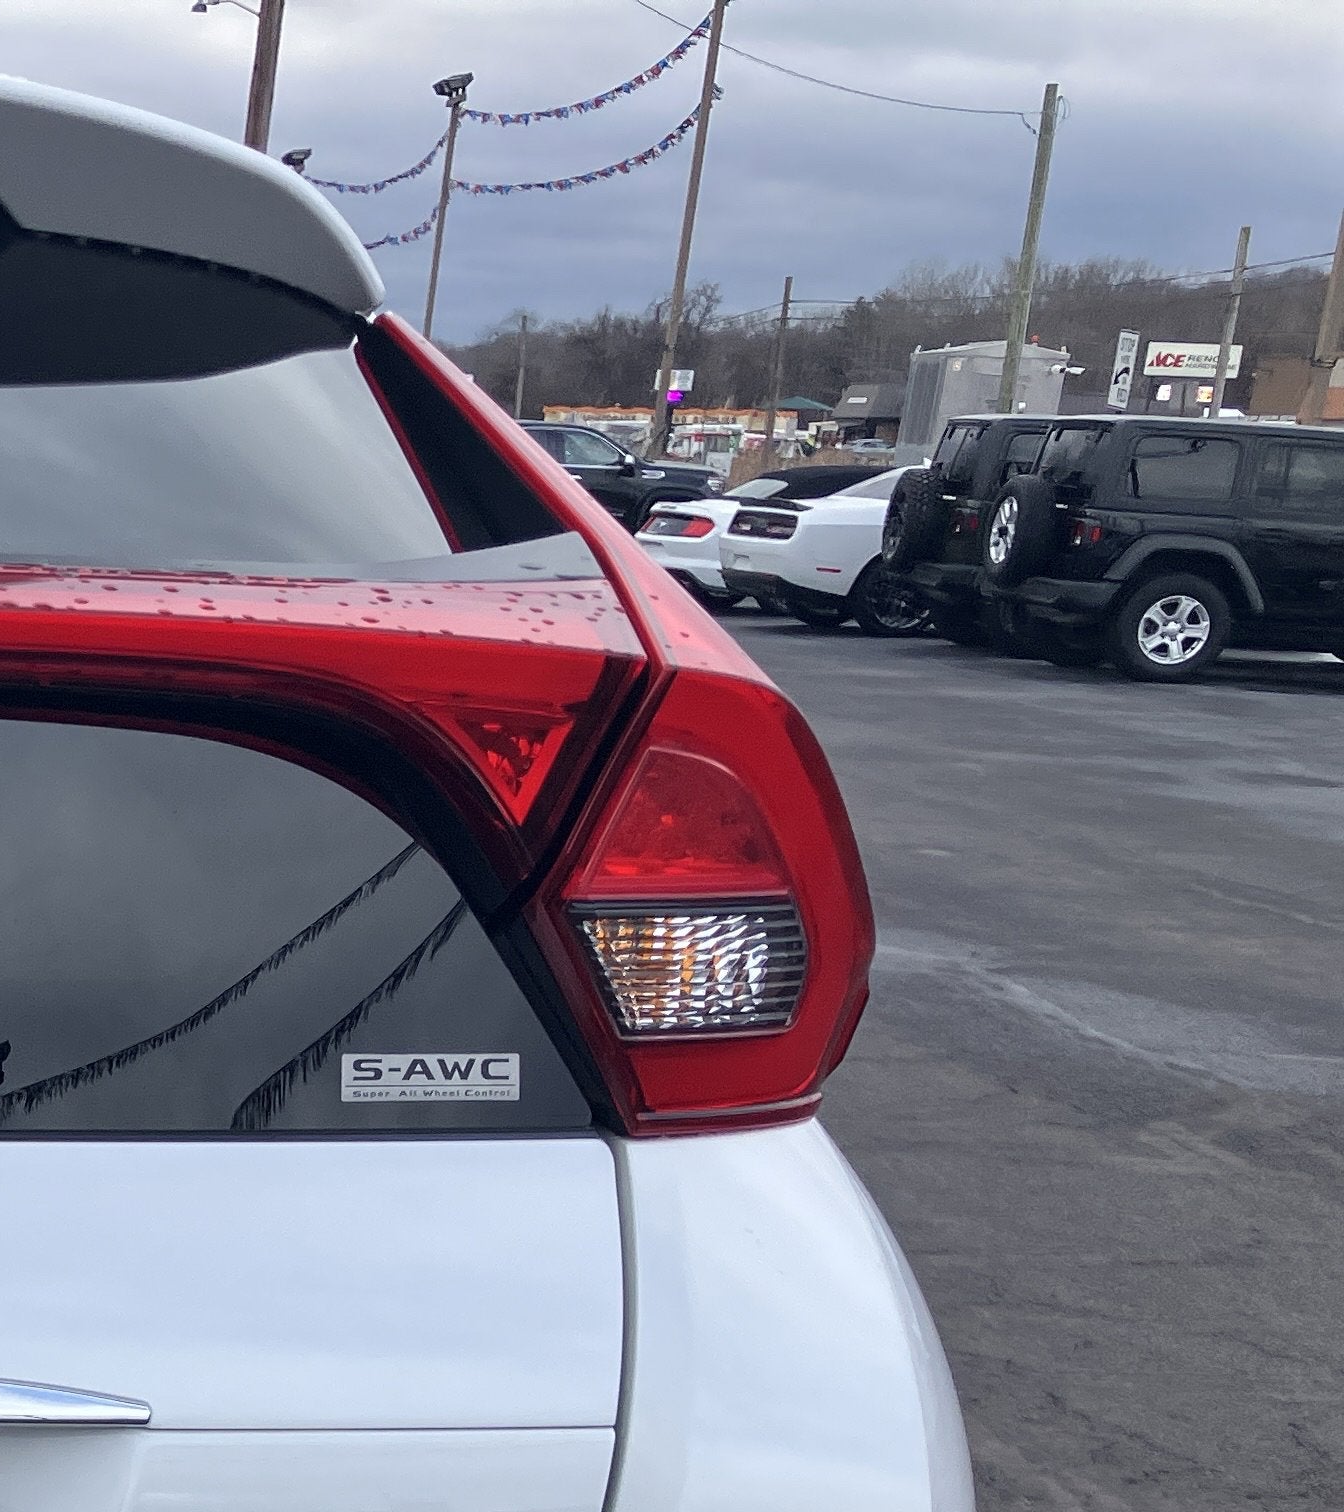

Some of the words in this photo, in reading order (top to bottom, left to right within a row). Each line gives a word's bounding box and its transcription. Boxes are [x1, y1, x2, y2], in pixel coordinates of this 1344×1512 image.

[1147, 351, 1187, 368] ACE
[352, 1057, 510, 1081] S-AWC
[352, 1089, 390, 1099] Super
[398, 1090, 418, 1098] All
[423, 1089, 460, 1098] Wheel
[464, 1089, 511, 1098] Control
